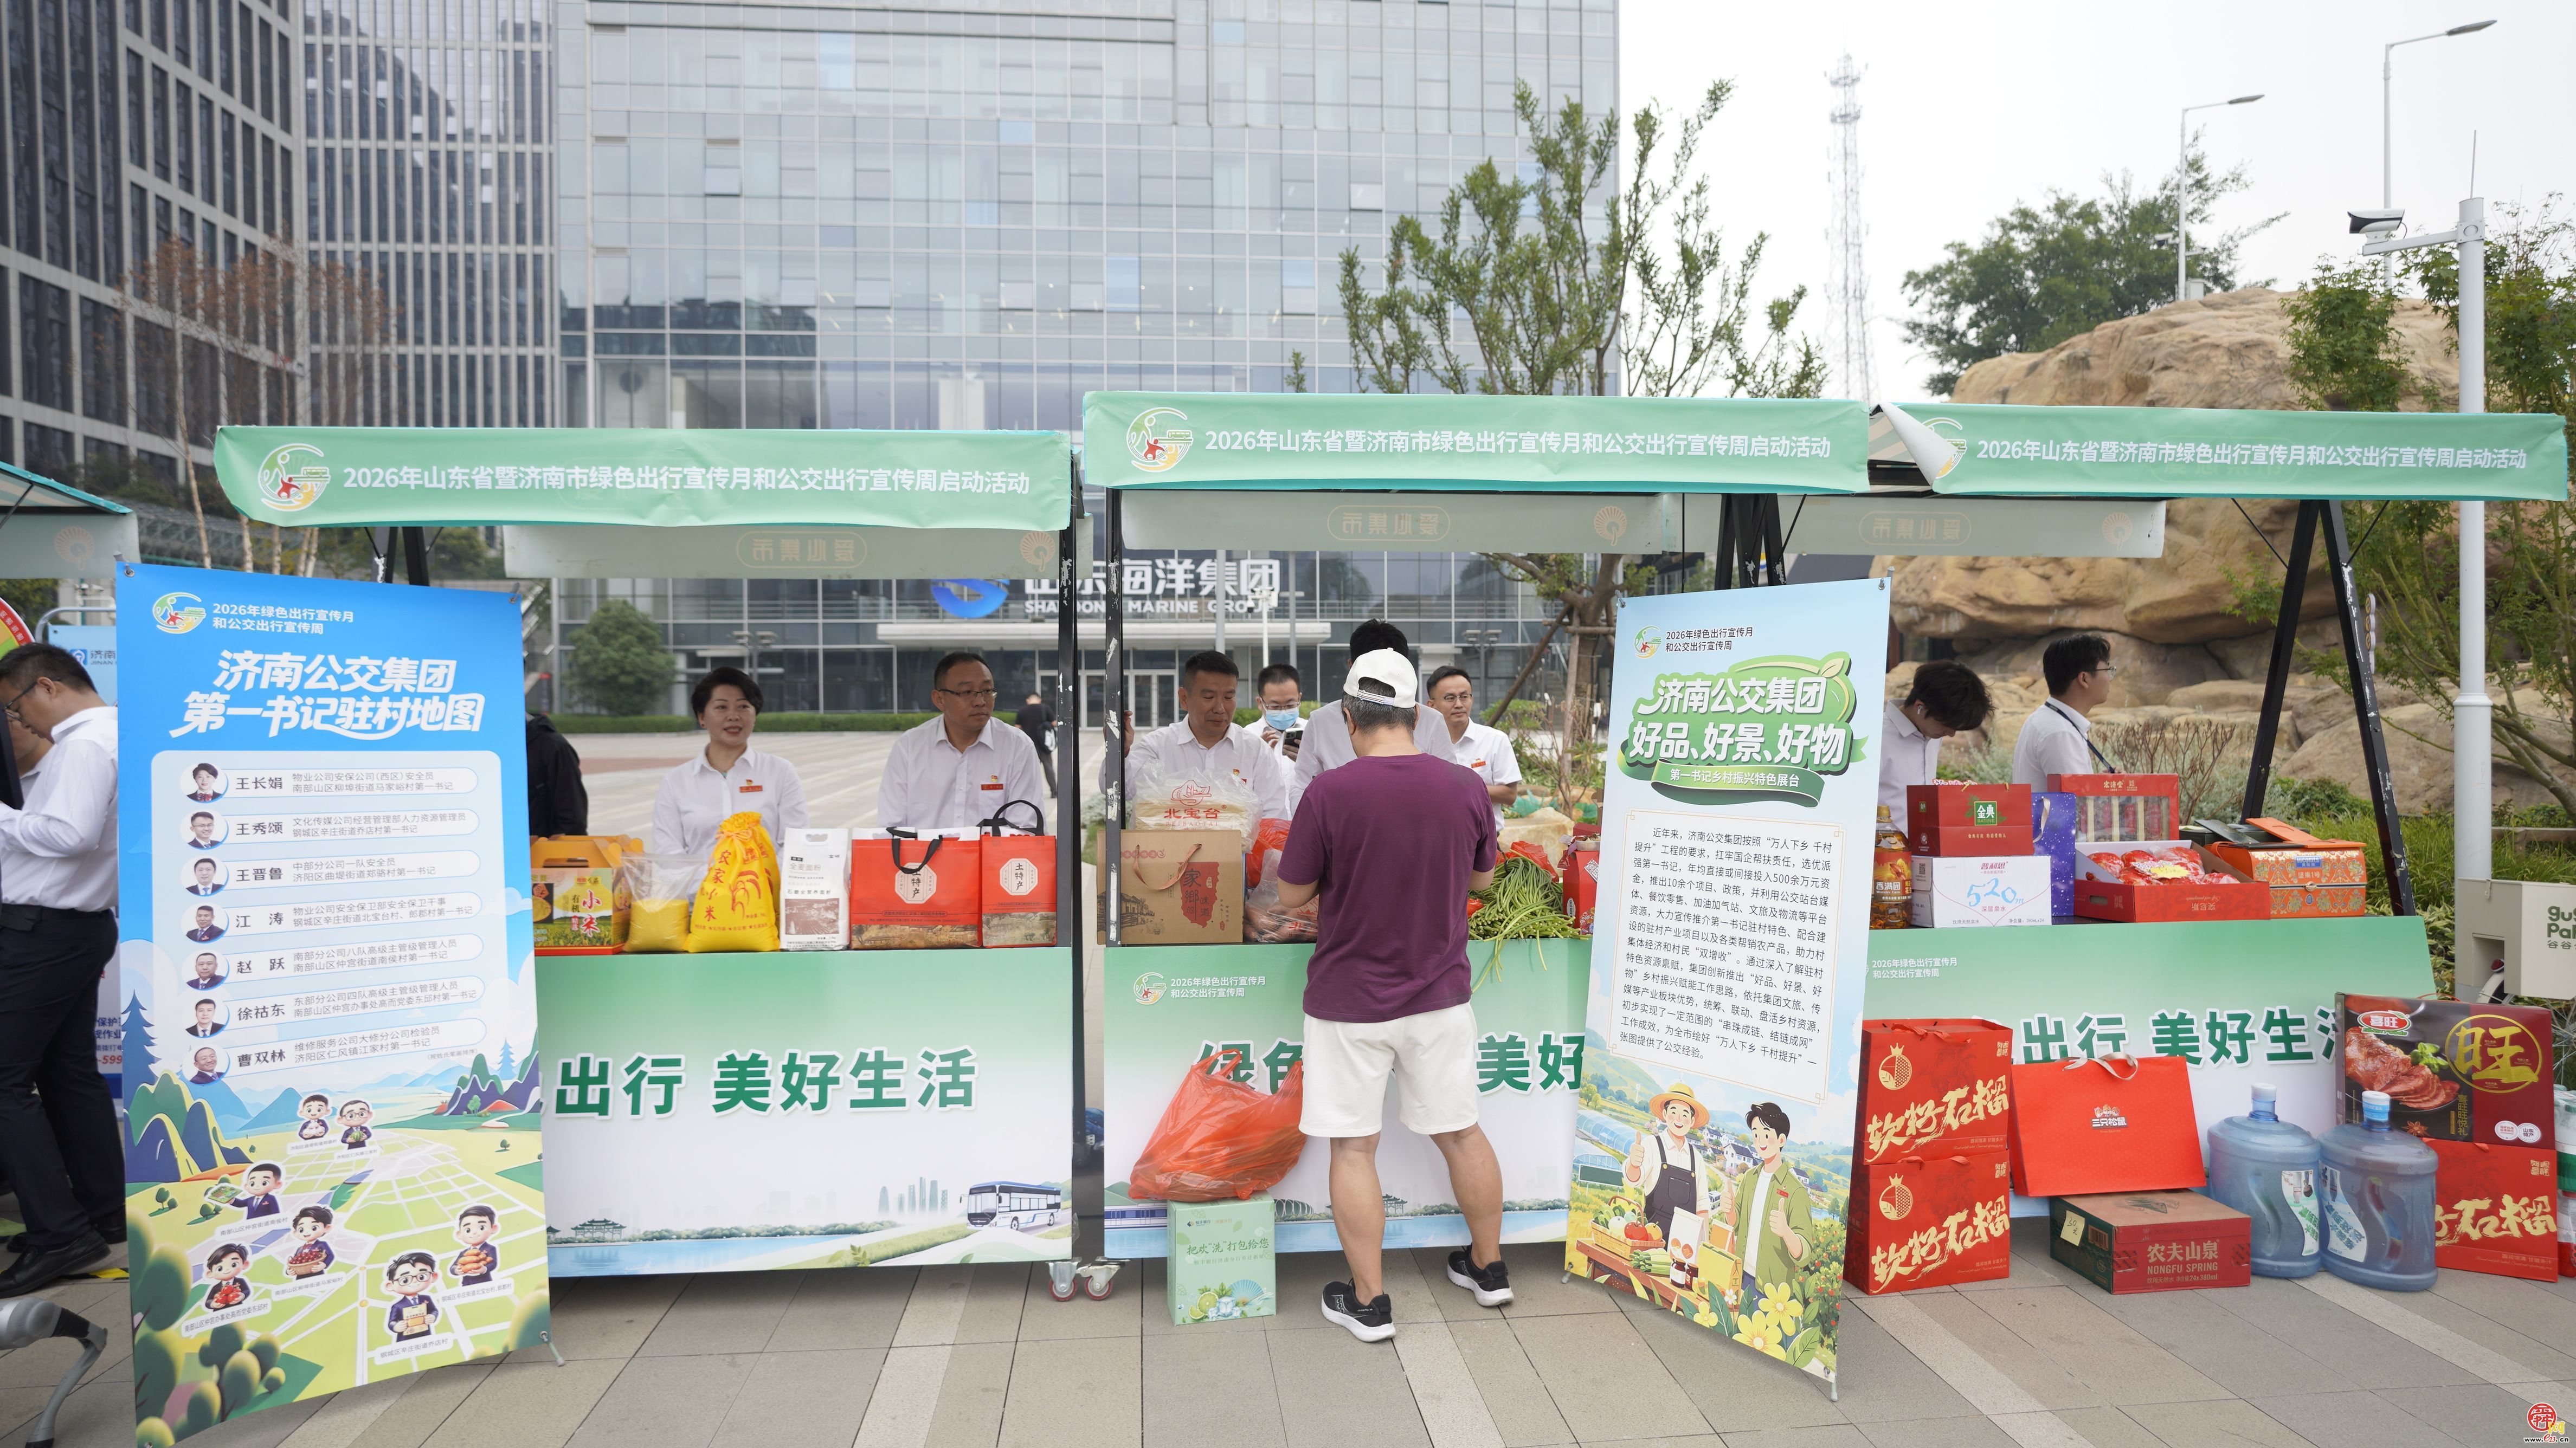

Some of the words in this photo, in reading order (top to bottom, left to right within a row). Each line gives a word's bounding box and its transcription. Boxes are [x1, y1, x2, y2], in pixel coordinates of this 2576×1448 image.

[1205, 429, 1831, 459] 2026年山东省暨济南市绿色出行宣传月和公交出行宣传周启动活动
[1977, 438, 2526, 470] 2026年山东省暨济南市绿色出行宣传月和公交出行宣传周启动活动
[343, 466, 1030, 494] 2026年山东省暨济南市绿色出行宣传月和公交出行宣传周启动活动
[212, 603, 354, 623] 2026年绿色出行宣传月
[1128, 600, 1199, 613] MARINE
[212, 617, 324, 635] 和公交出行宣传周
[1666, 626, 1753, 640] 2026年绿色出行宣传月
[1665, 641, 1732, 652] 和公交出行宣传周
[212, 650, 457, 693] 济南公交集团
[1637, 676, 1827, 715] 济南公交集团
[169, 691, 485, 740] 第一书记驻村地图
[1629, 721, 1846, 765] 好品、好景、好物
[1670, 768, 1800, 787] 第一书记乡村振兴特色展台
[1164, 807, 1222, 819] 北宝台
[1976, 804, 1995, 819] 金典
[1813, 841, 1833, 854] 千村
[1015, 863, 1024, 891] 土特产
[1876, 882, 1901, 890] 香满园
[236, 914, 251, 928] 江
[269, 912, 284, 926] 涛
[582, 889, 602, 938] 小米
[236, 959, 252, 974] 赵
[269, 957, 286, 971] 跃
[1872, 957, 1957, 968] 2026年绿色出行宣传月
[1170, 976, 1266, 987] 2026年绿色出行宣传月
[1873, 968, 1940, 979] 和公交出行宣传周
[1170, 987, 1245, 998] 和公交出行宣传周
[2369, 1015, 2398, 1028] 喜旺
[1620, 1031, 1704, 1060] 张图提供了公交经验。
[2453, 1025, 2539, 1084] 旺
[237, 1049, 286, 1068] 曹双林
[554, 1055, 684, 1117] 出行
[711, 1045, 977, 1115] 美好生活
[2092, 1116, 2127, 1127] 三只松鼠
[2457, 1094, 2468, 1136] 喜旺旺悦礼
[2147, 1240, 2219, 1263] 农夫山泉
[2147, 1264, 2182, 1275] NONGFU
[2186, 1262, 2218, 1273] SPRING
